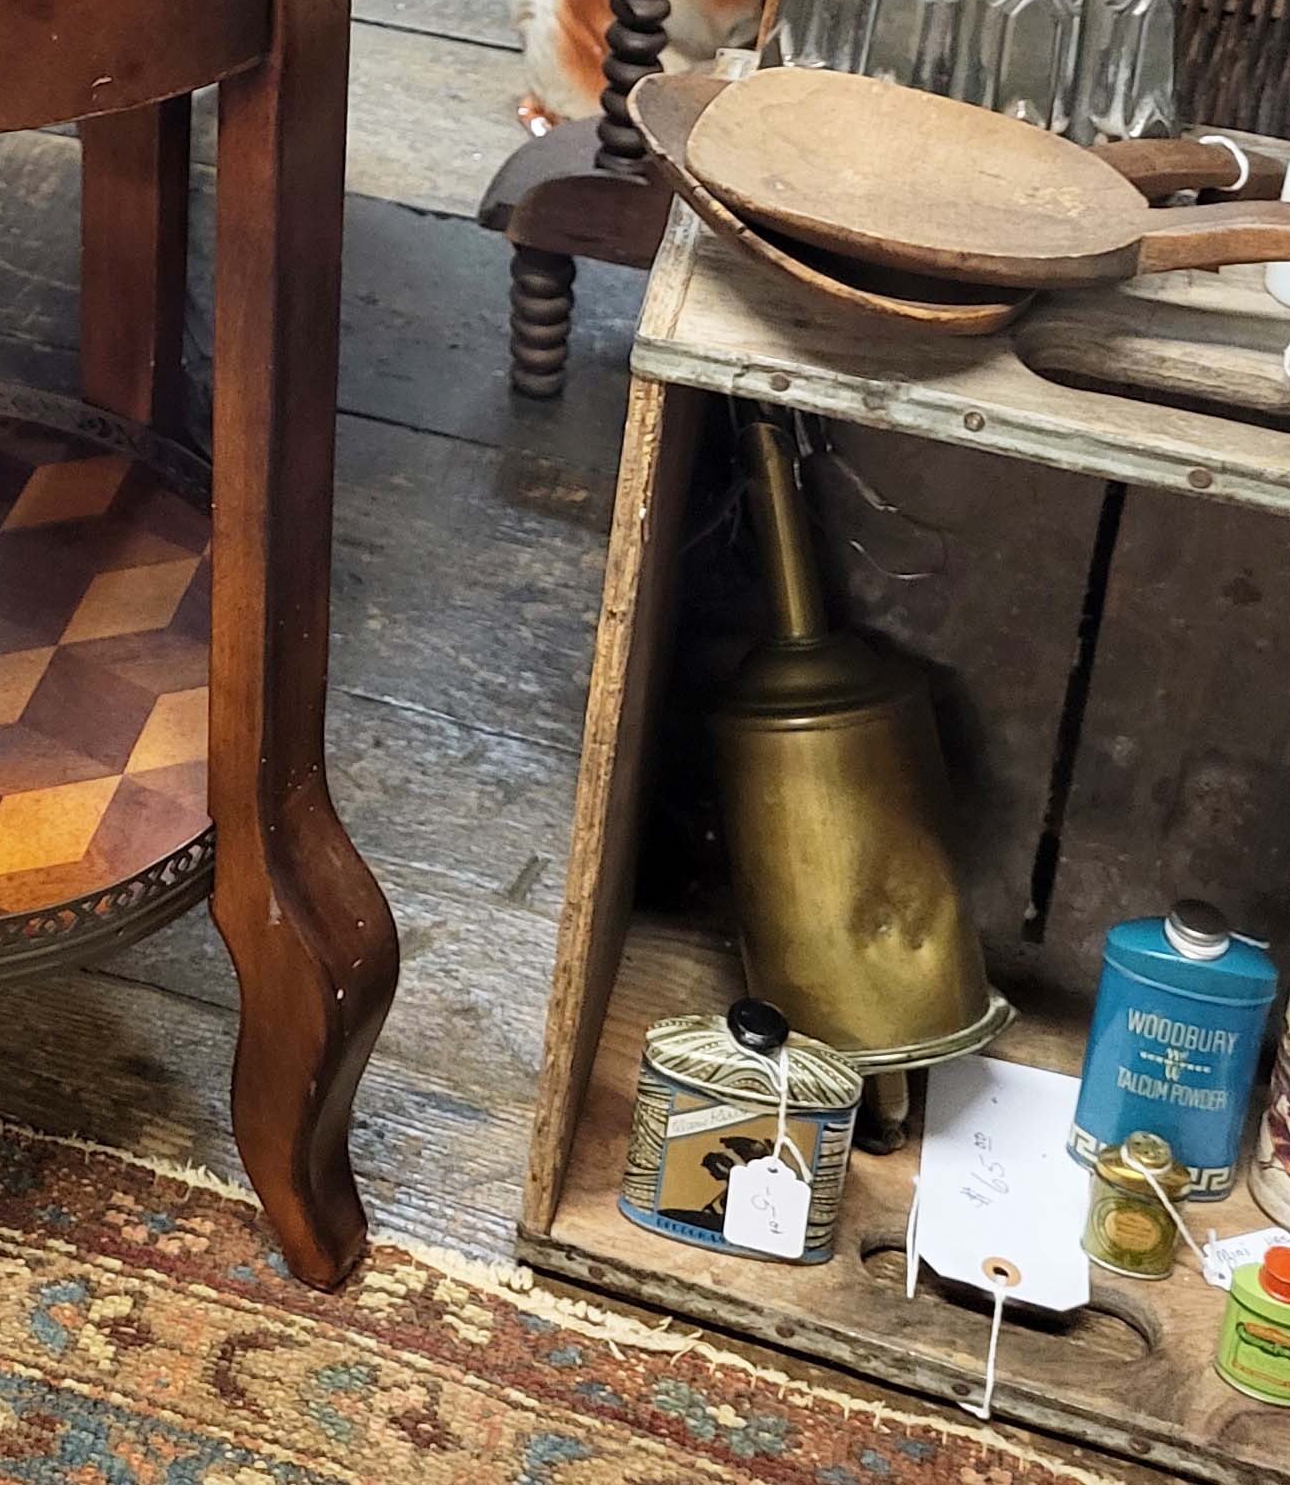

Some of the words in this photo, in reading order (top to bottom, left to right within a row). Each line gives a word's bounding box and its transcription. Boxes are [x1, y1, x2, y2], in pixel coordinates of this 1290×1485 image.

[1127, 1008, 1240, 1055] WOODBURY
[1117, 1066, 1168, 1102] TALCUM
[1169, 1083, 1229, 1112] POWDER
